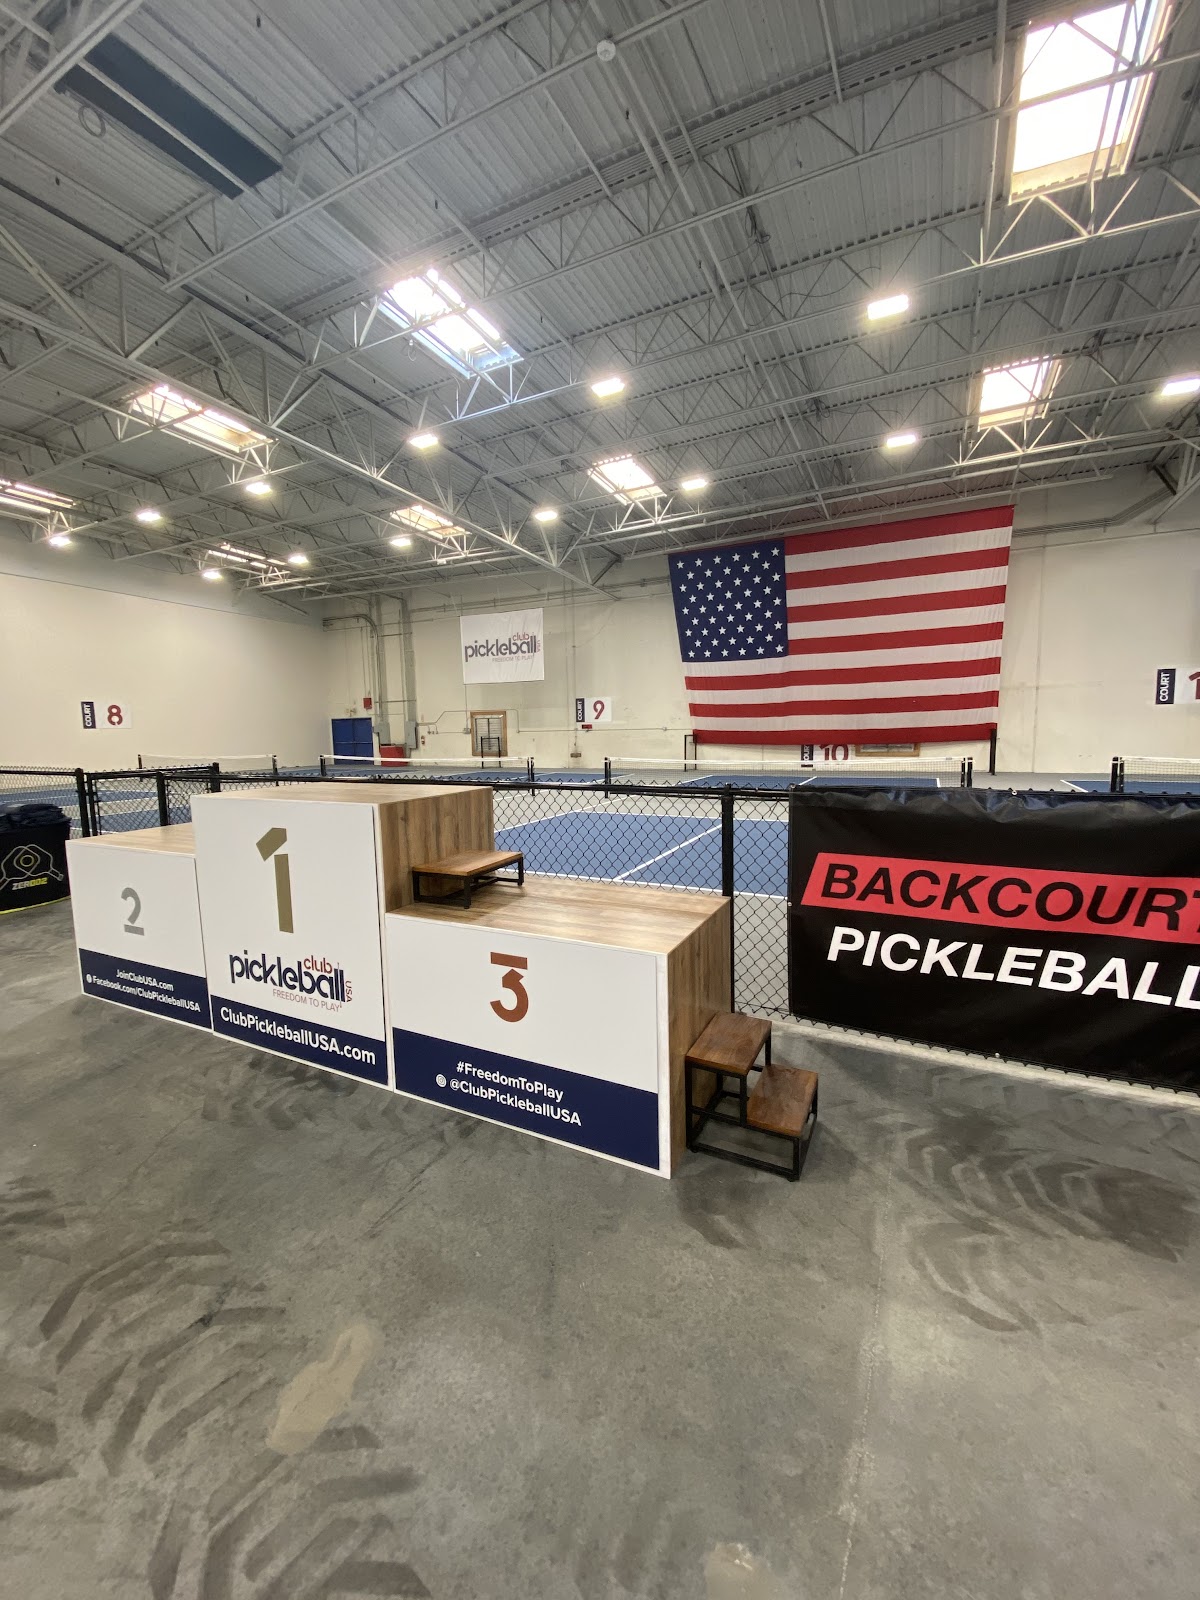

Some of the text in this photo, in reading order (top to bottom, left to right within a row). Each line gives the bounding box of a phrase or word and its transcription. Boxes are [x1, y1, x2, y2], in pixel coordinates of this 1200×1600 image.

[464, 635, 536, 662] pickleball
[512, 632, 529, 641] club
[1159, 672, 1170, 702] COURT
[83, 703, 92, 727] COURT
[107, 704, 123, 726] 8
[593, 700, 605, 720] 9
[819, 744, 849, 761] 10
[256, 827, 294, 934] 1
[121, 887, 145, 936] 2
[229, 949, 346, 1003] pickleball
[303, 955, 333, 974] club
[92, 975, 201, 1013] Facebook.com/ClubPickleballUSA
[116, 969, 174, 992] JoinClubUSA.com
[345, 980, 353, 1003] USA
[490, 952, 529, 1022] 3
[272, 988, 340, 1013] FREEDOM TO PLAY
[220, 1006, 376, 1066] ClubPickleballUSA.com
[456, 1060, 564, 1103] #FreedomToPlay
[449, 1078, 582, 1127] @ClubPickleballUSA
